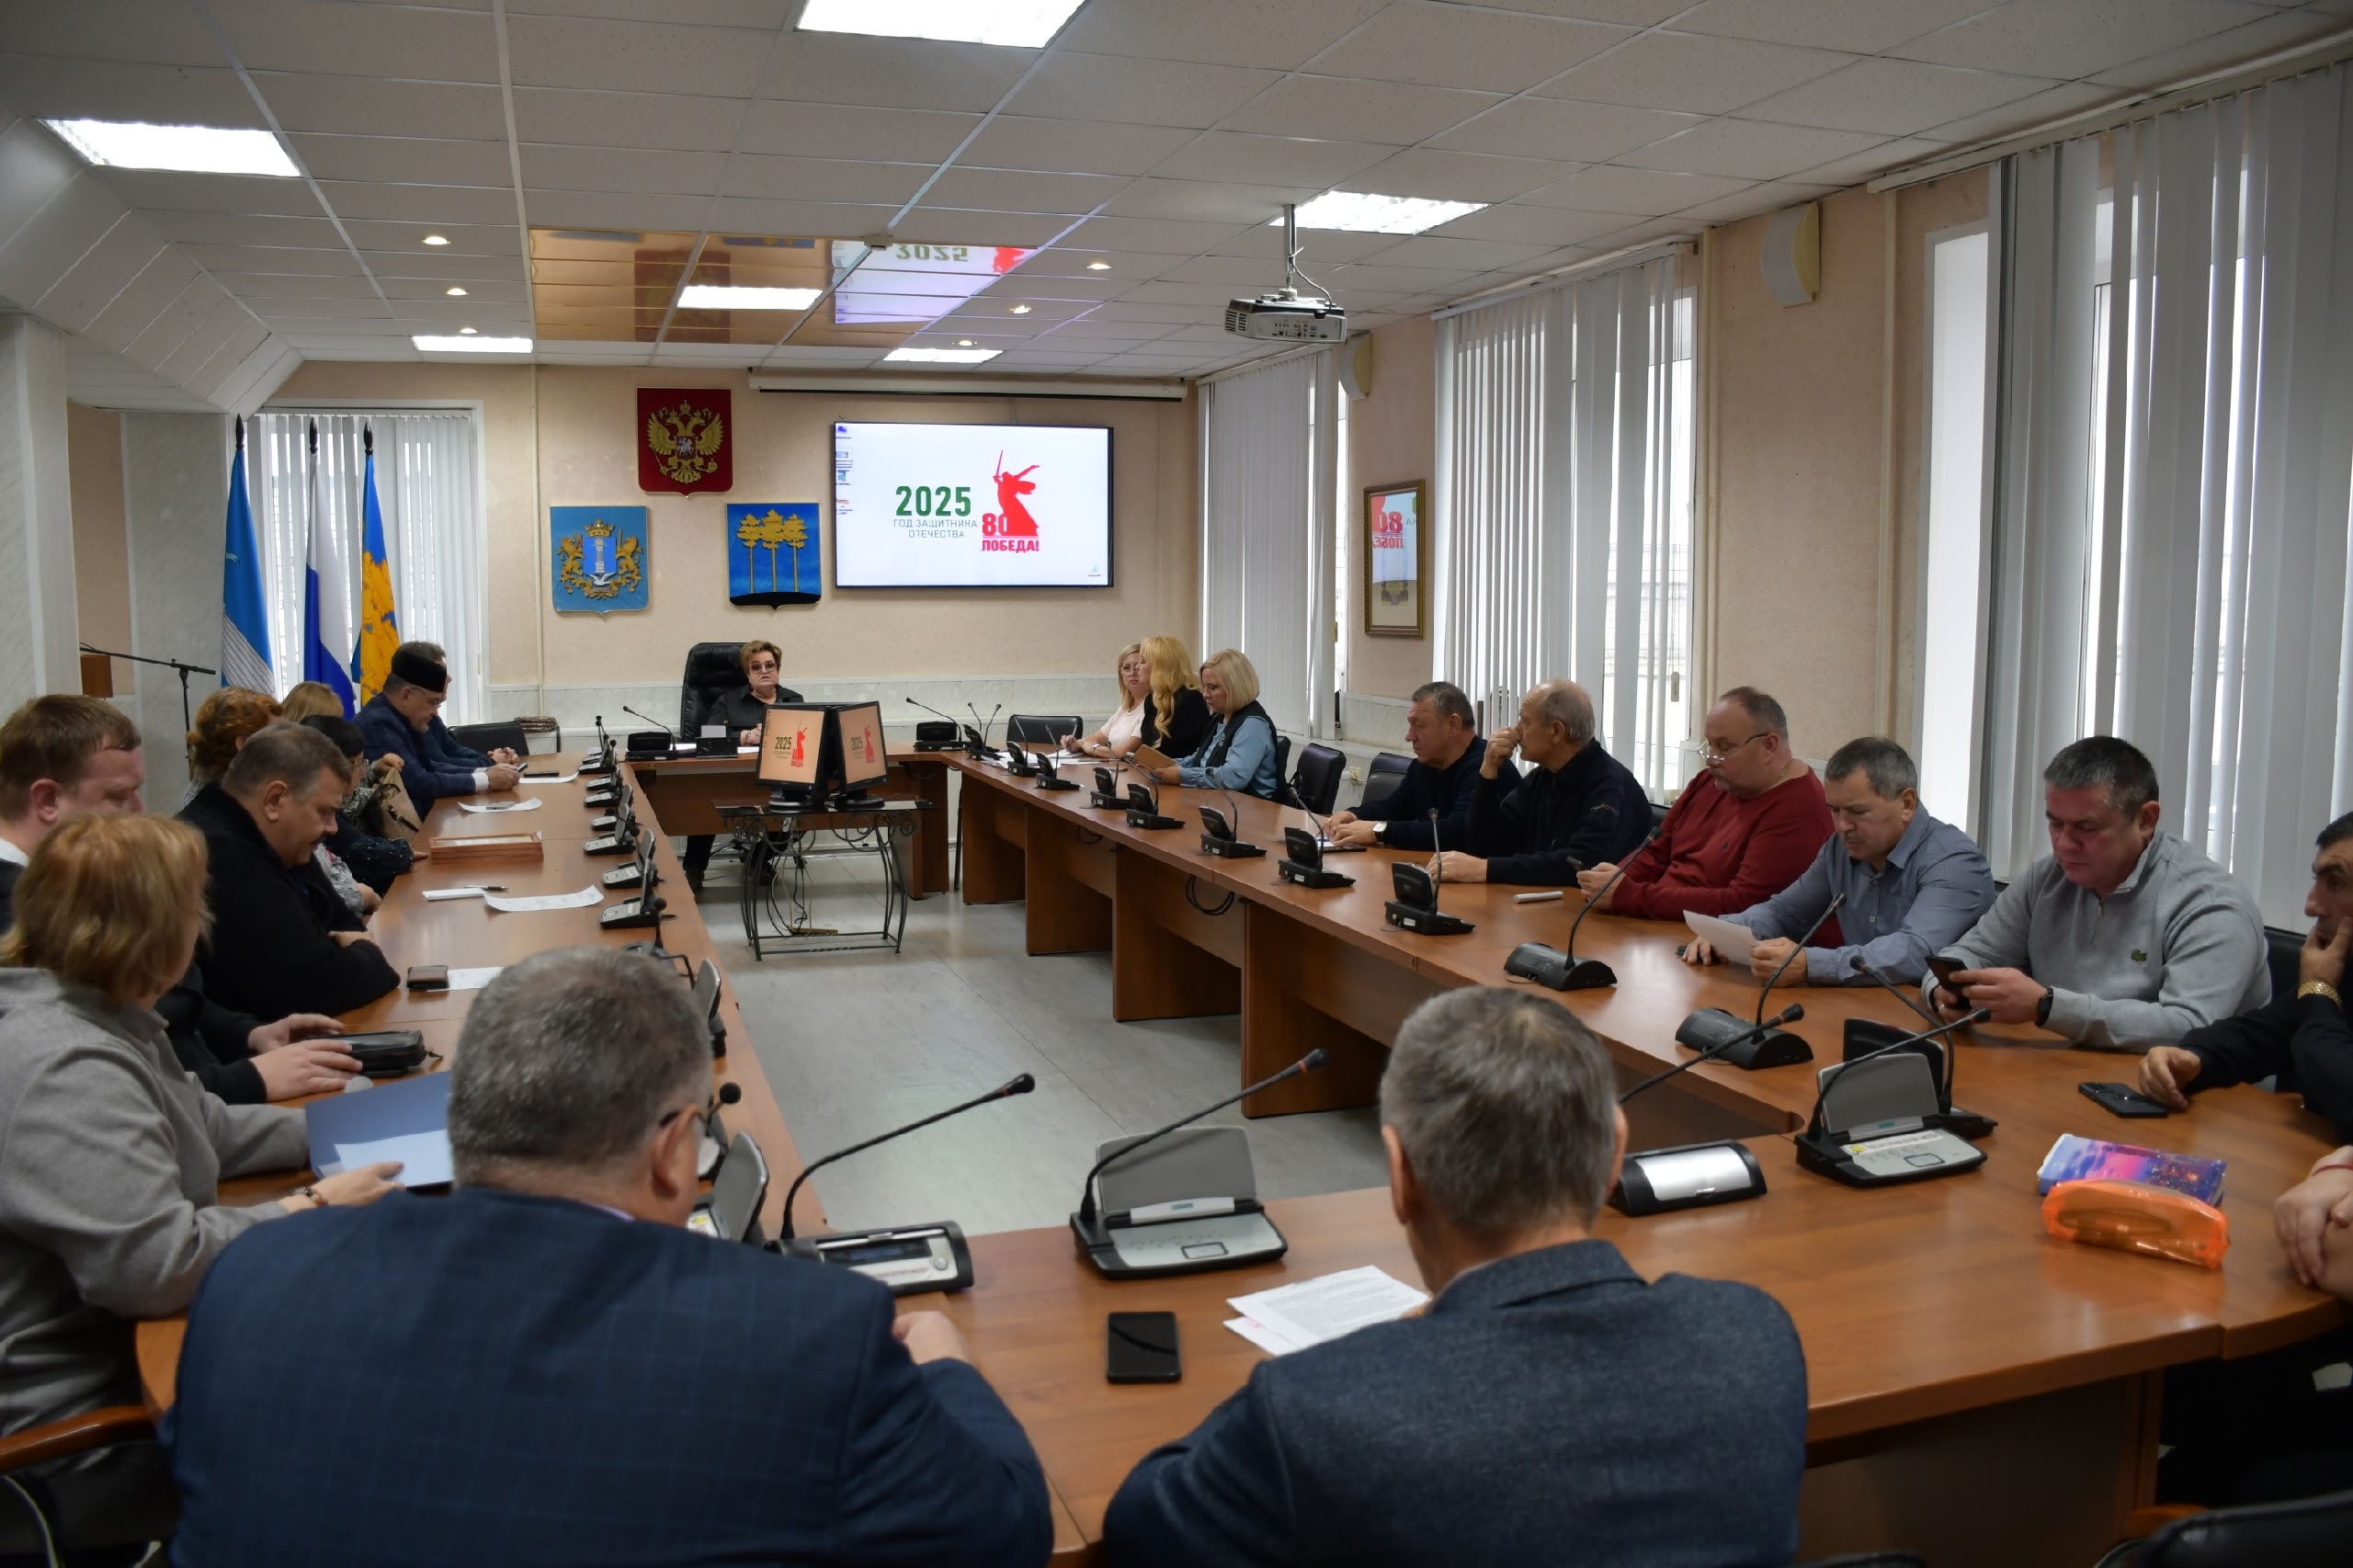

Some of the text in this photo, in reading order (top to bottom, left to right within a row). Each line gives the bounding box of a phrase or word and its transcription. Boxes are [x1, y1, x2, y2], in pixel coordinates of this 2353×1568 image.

[895, 485, 971, 517] 2025
[893, 518, 978, 528] ГОД ЗАЩИТНИКА
[983, 513, 1009, 536] 80
[908, 529, 964, 539] ОТЕЧЕСТВА
[982, 540, 1040, 553] ПОБЕДА!
[774, 736, 792, 750] 2025
